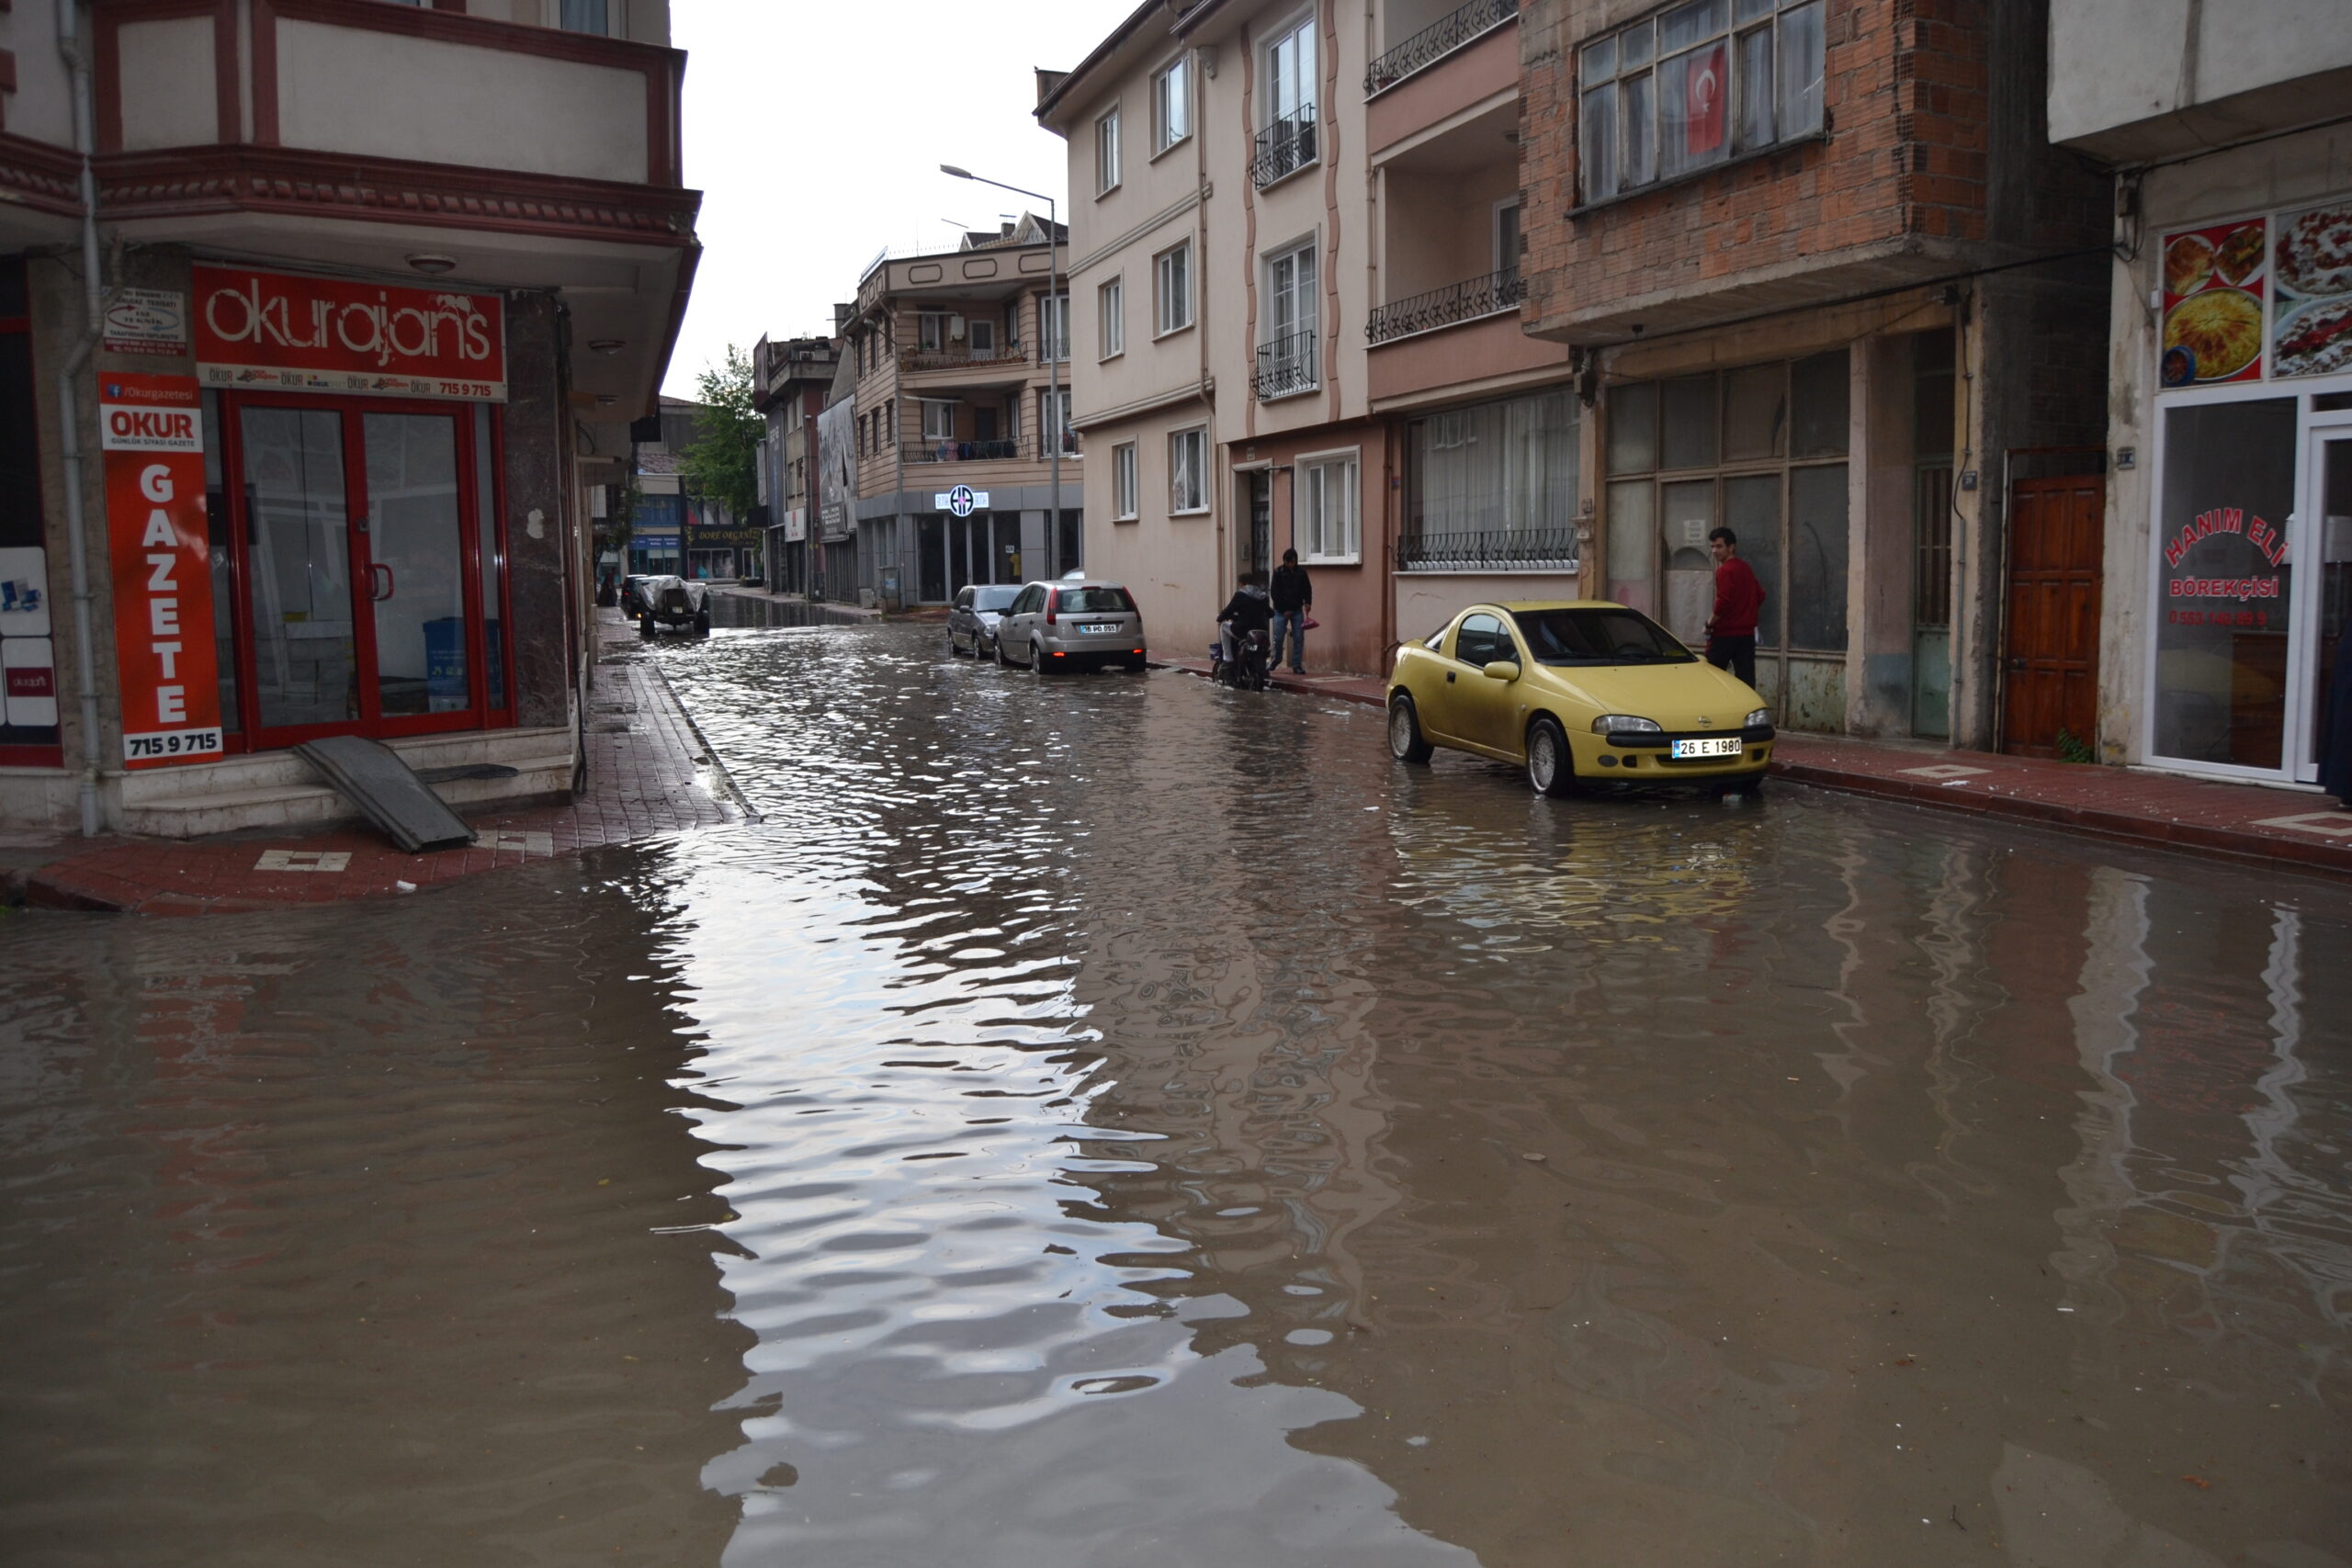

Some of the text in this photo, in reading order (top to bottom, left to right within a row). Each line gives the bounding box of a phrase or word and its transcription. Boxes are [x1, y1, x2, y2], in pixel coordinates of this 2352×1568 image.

[207, 277, 491, 367] okurajans
[439, 382, 459, 395] 715
[462, 383, 469, 395] 9
[471, 385, 492, 397] 715
[110, 411, 195, 438] OKUR
[111, 437, 141, 446] GÜNLÜK
[168, 439, 196, 447] GAZETE
[2165, 507, 2289, 569] HANIM ELİ
[140, 464, 187, 724] GAZETE
[2169, 575, 2279, 602] BÖREKÇİSİ
[130, 733, 218, 755] 715 9 715
[1680, 739, 1740, 755] 26 E 1980
